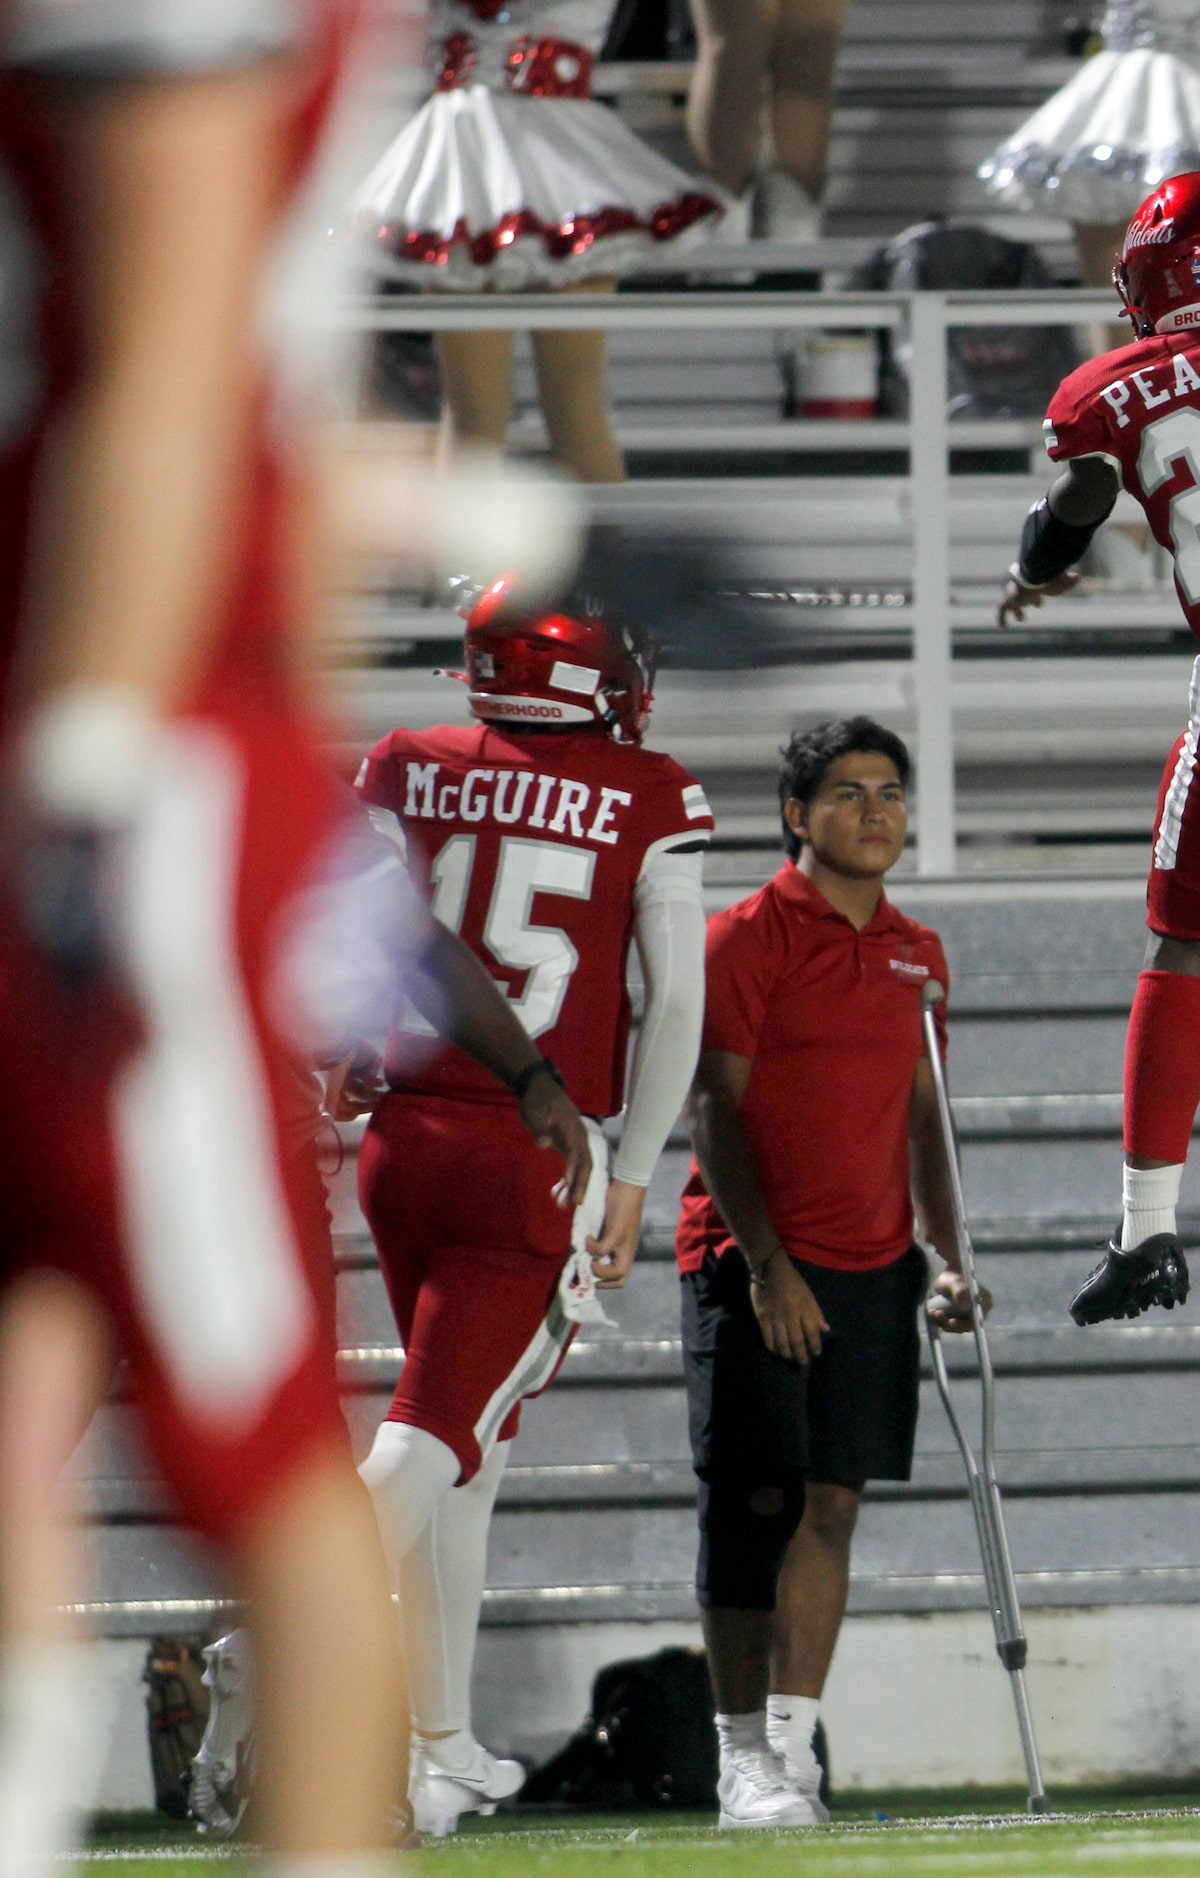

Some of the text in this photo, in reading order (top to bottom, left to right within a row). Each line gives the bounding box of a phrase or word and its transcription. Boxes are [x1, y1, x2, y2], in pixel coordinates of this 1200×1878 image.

[1122, 216, 1176, 264] ildcats
[404, 762, 632, 844] McGUIRE
[397, 833, 598, 1040] 15
